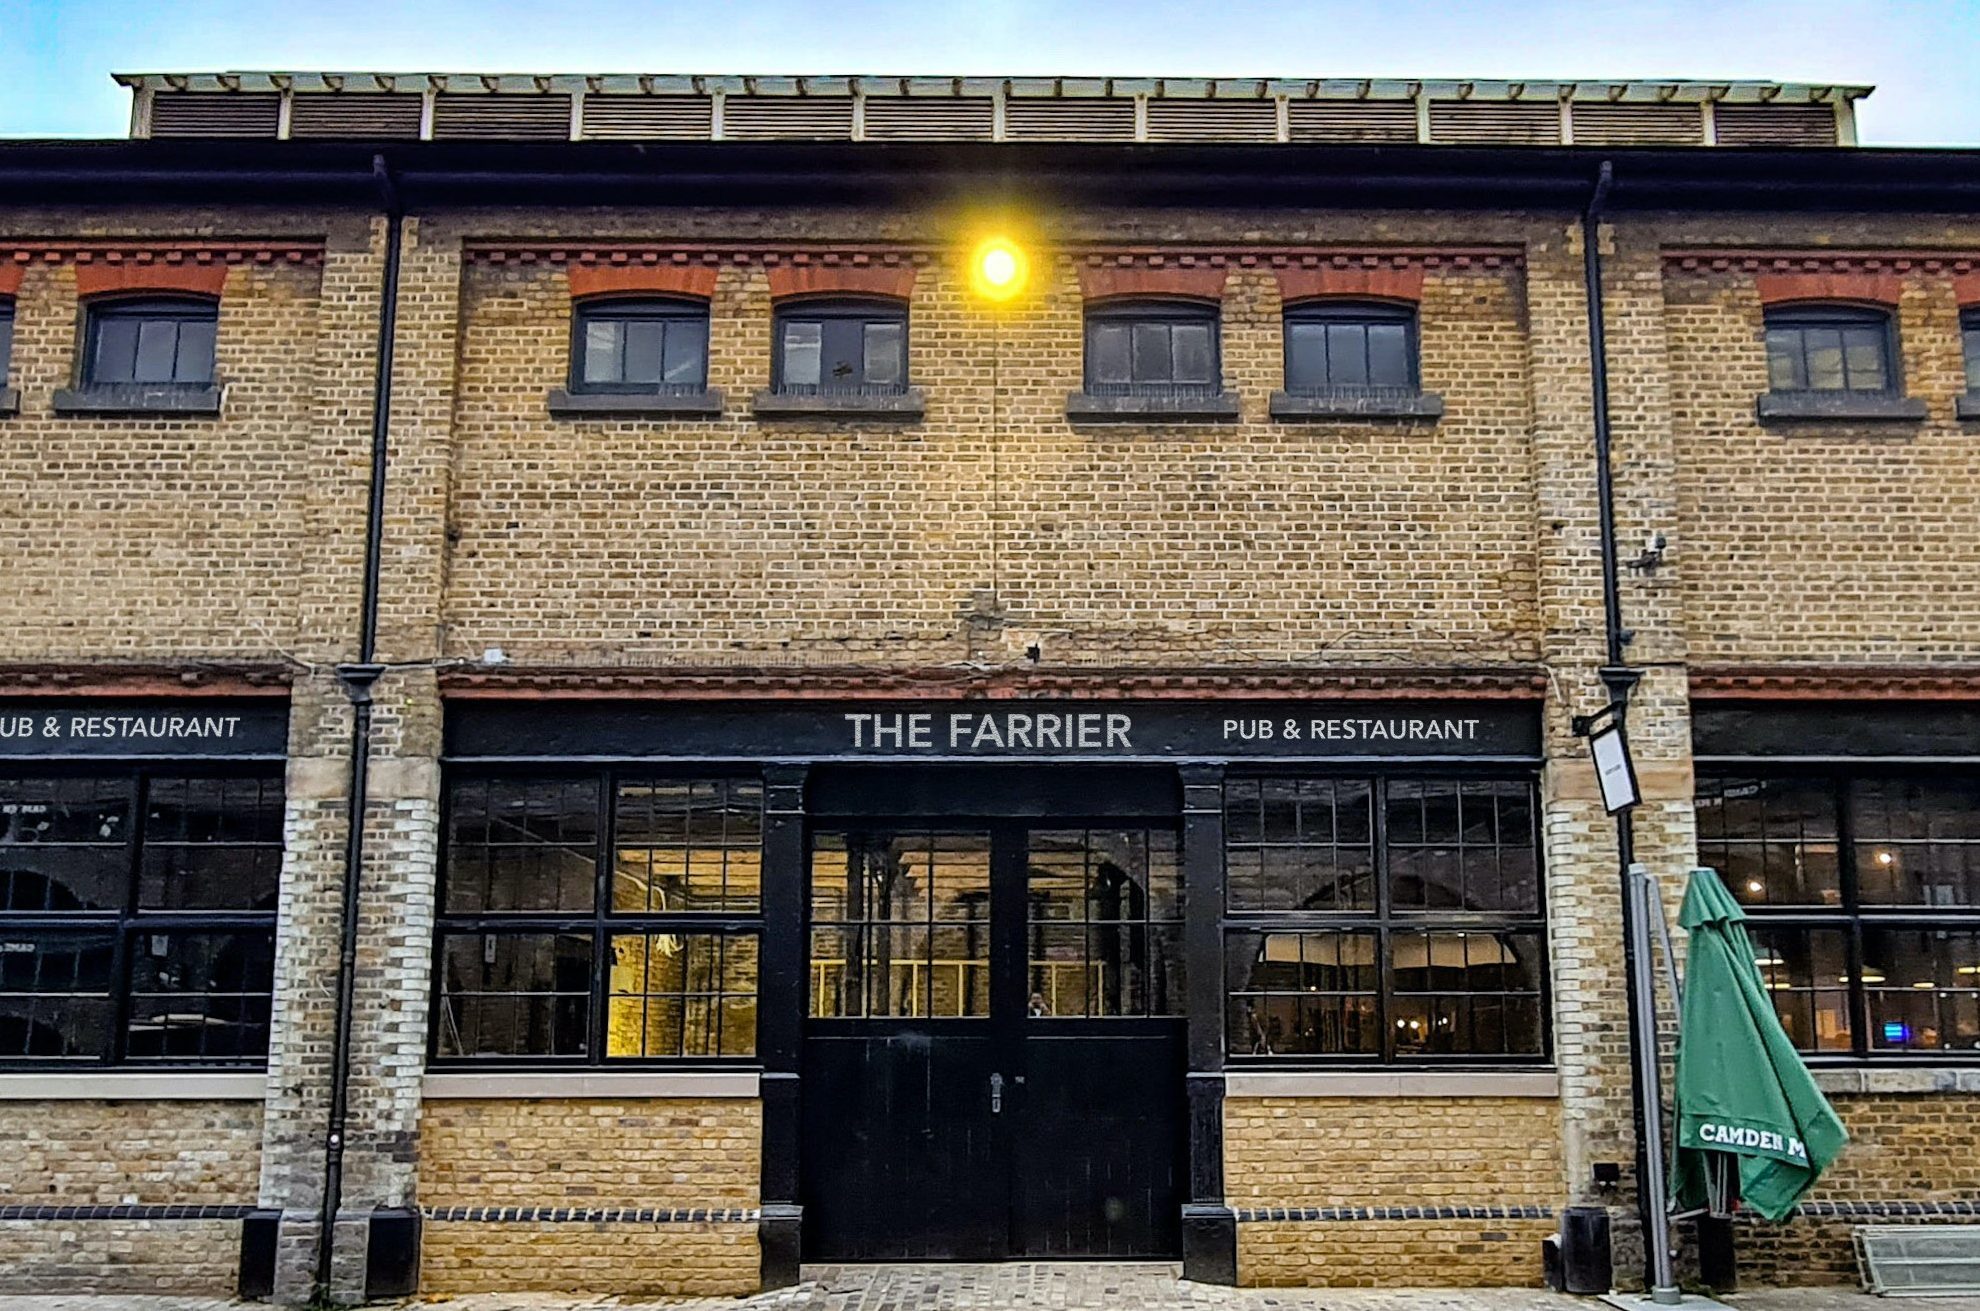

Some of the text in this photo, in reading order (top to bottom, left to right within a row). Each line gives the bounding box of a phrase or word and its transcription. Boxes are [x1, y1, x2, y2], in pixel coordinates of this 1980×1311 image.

[42, 716, 61, 738] &
[70, 716, 241, 738] RESTAURANT
[844, 713, 1133, 748] THE FARRIER
[1223, 718, 1480, 740] PUB & RESTAURANT
[1699, 1123, 1784, 1151] CAMDEN
